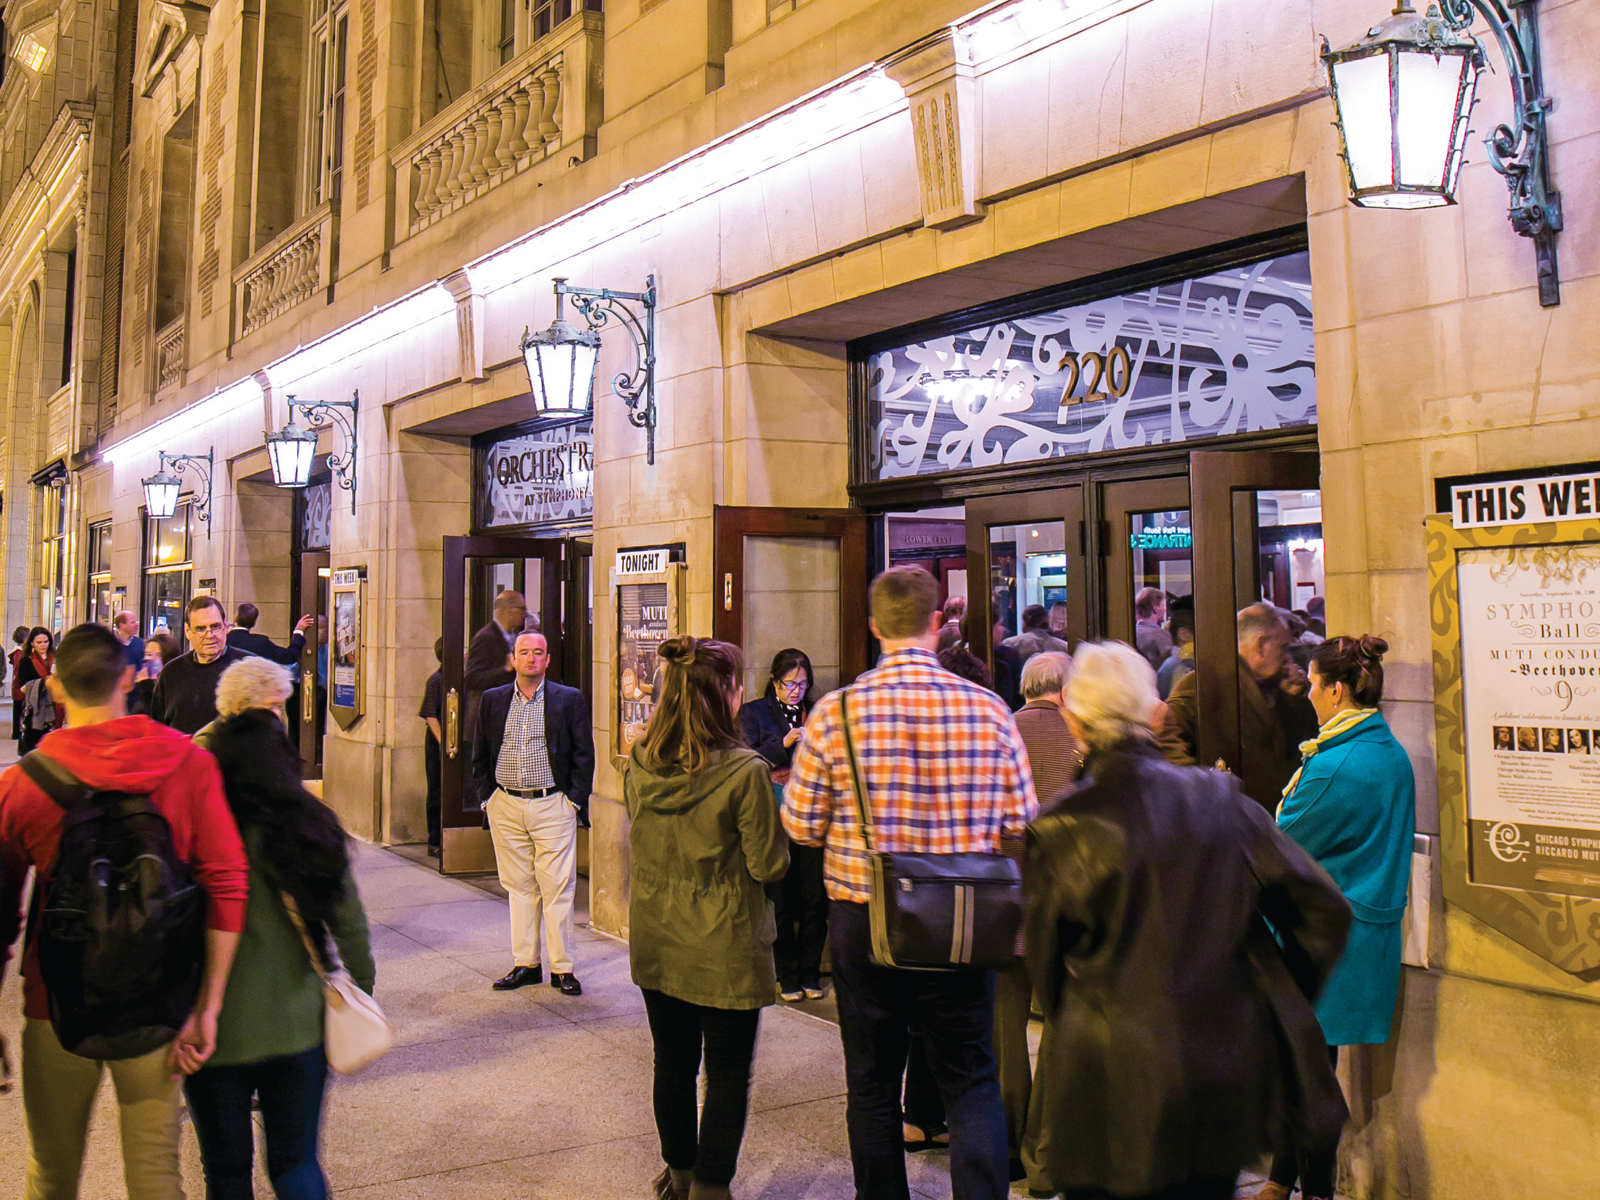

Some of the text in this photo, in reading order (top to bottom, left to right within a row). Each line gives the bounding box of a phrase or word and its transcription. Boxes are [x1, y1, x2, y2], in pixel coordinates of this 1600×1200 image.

[1058, 347, 1131, 406] 220
[524, 486, 588, 506] AT SYMPHONY
[1456, 485, 1526, 524] THIS
[905, 535, 954, 544] LOWER LEVEL
[621, 553, 659, 572] TONIGHT
[642, 606, 667, 620] MUTI
[1486, 601, 1600, 621] SYMPHO
[1540, 623, 1580, 638] Ball
[1490, 649, 1533, 660] MUTI
[1554, 680, 1573, 712] 9
[1535, 833, 1569, 846] CHICAGO
[1535, 845, 1579, 859] RICCARDO
